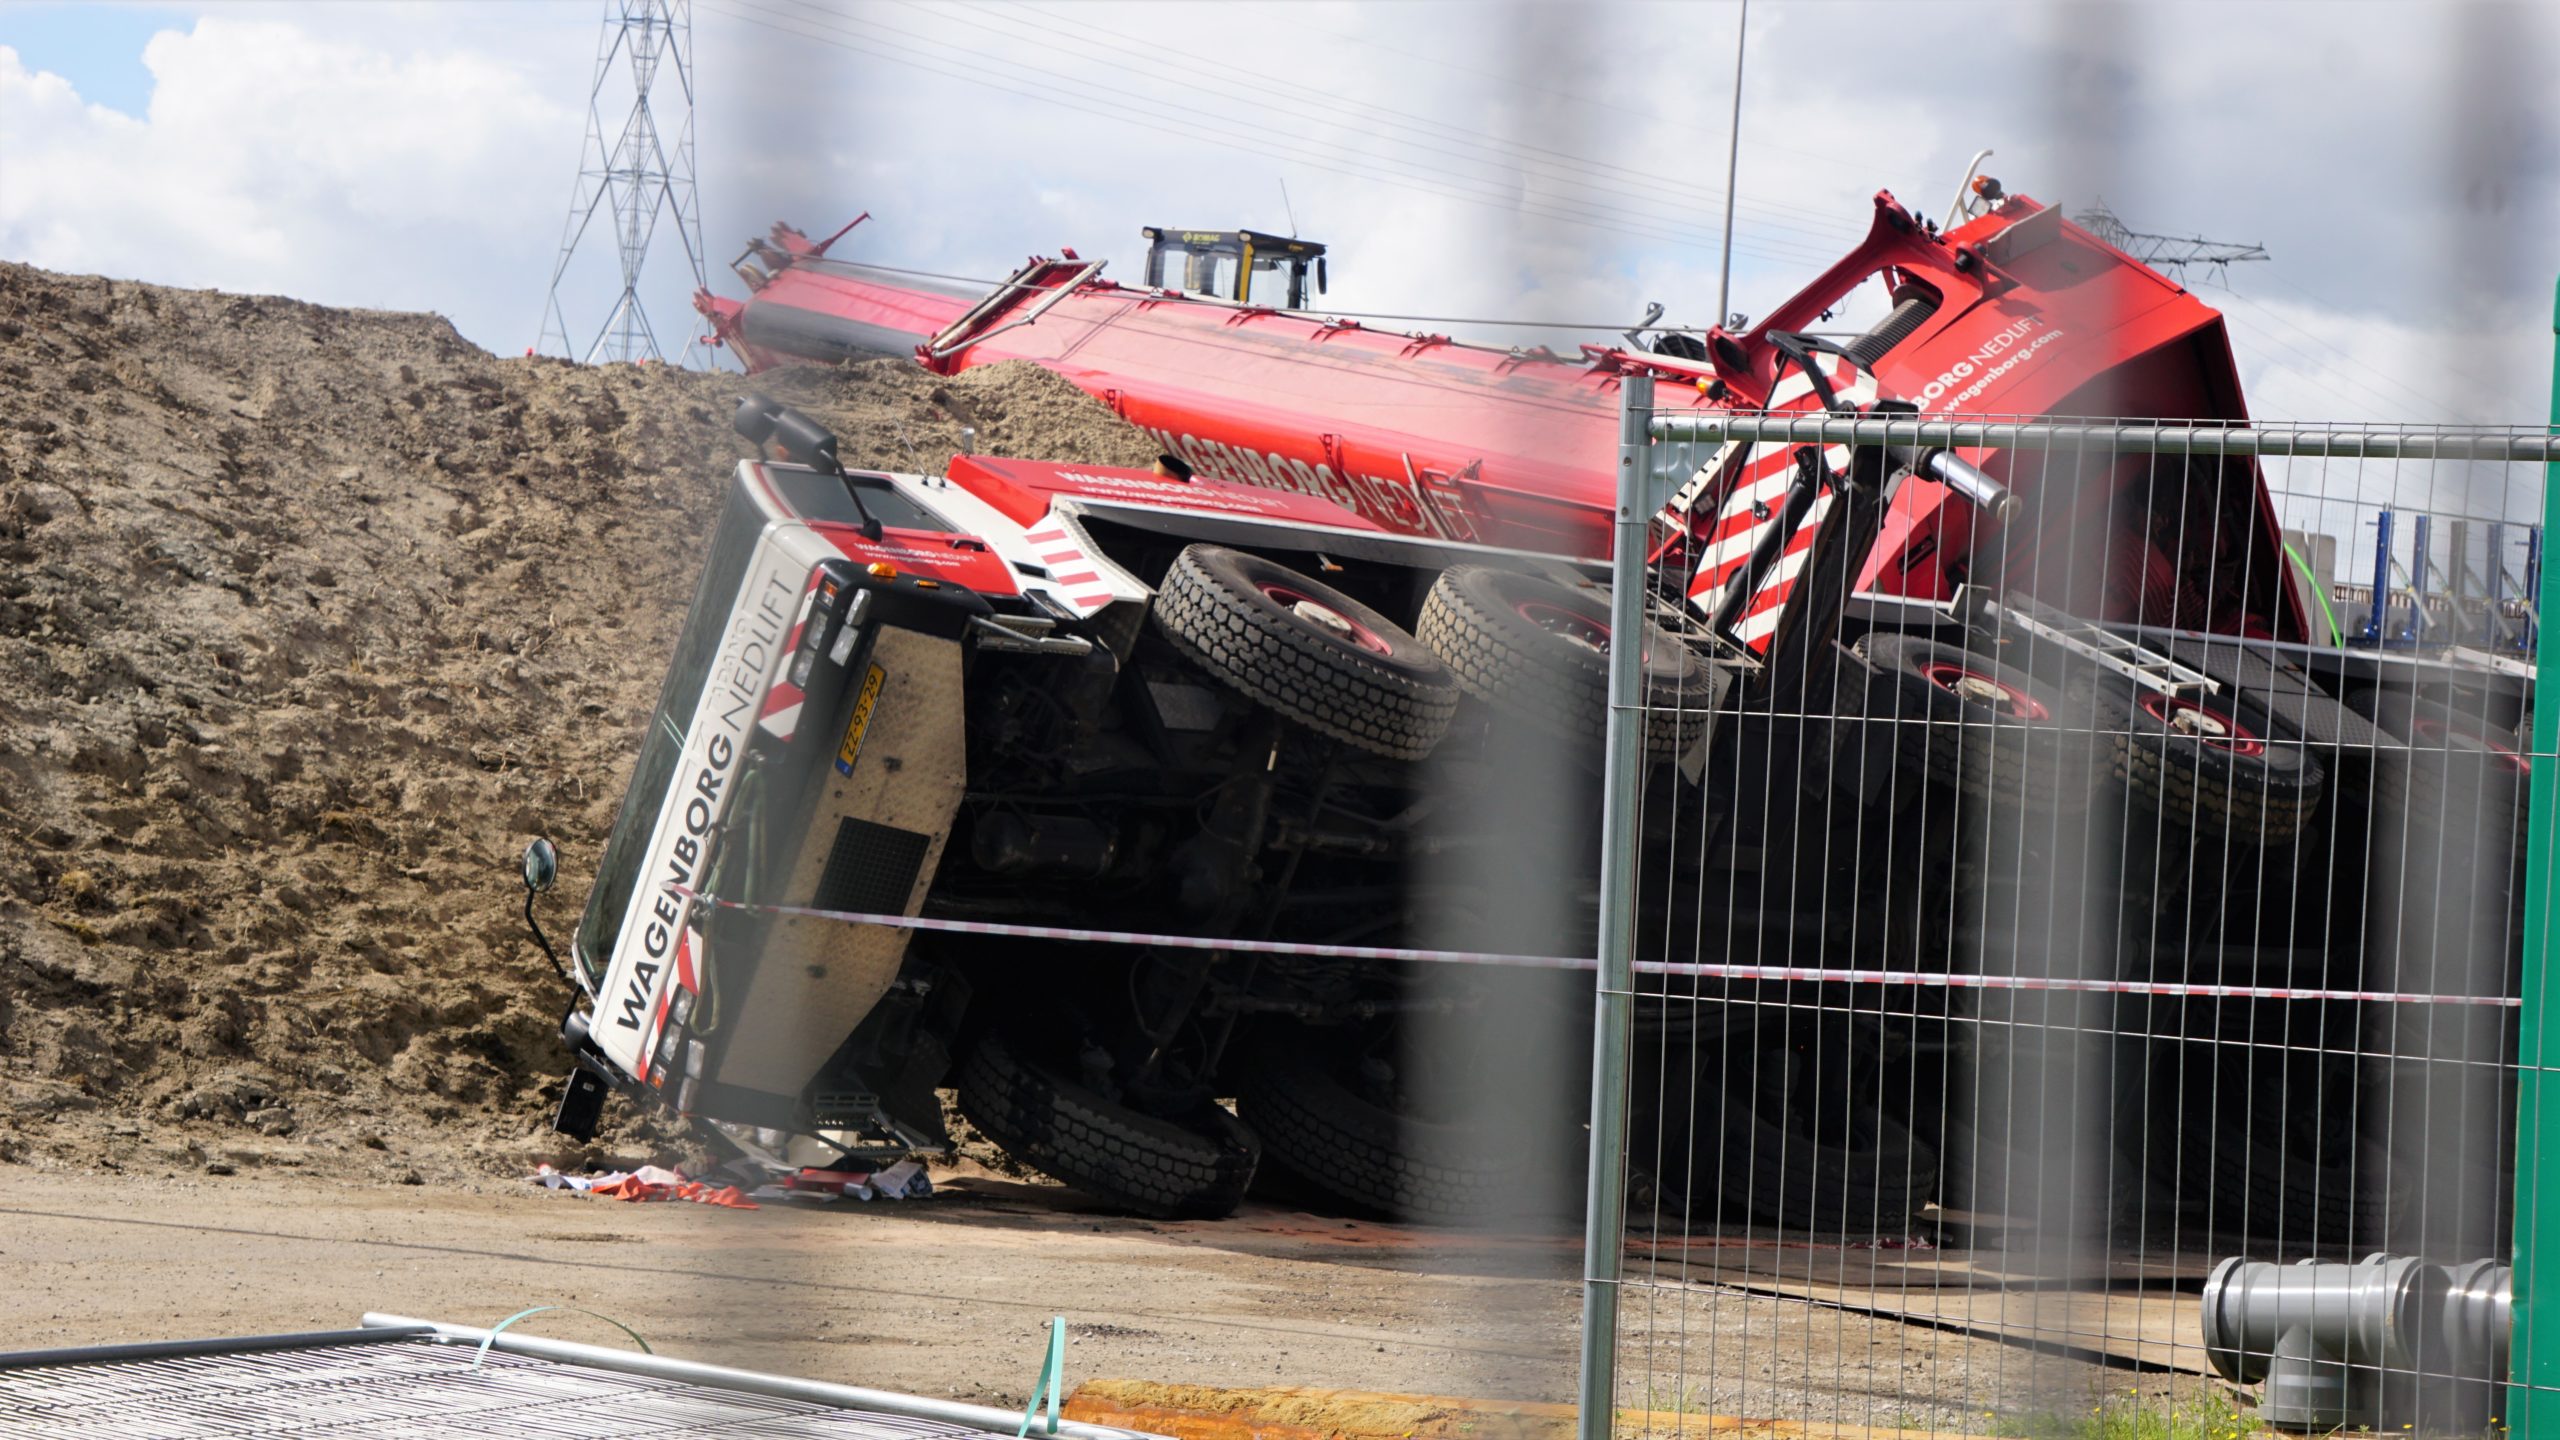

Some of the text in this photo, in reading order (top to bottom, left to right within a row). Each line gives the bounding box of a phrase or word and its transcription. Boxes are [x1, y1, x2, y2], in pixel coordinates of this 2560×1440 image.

[1896, 315, 2044, 412] BORG NEDLIFT
[1055, 471, 1214, 499] WAGENBORG
[617, 569, 793, 1031] WAGENBORG NEDLIFT
